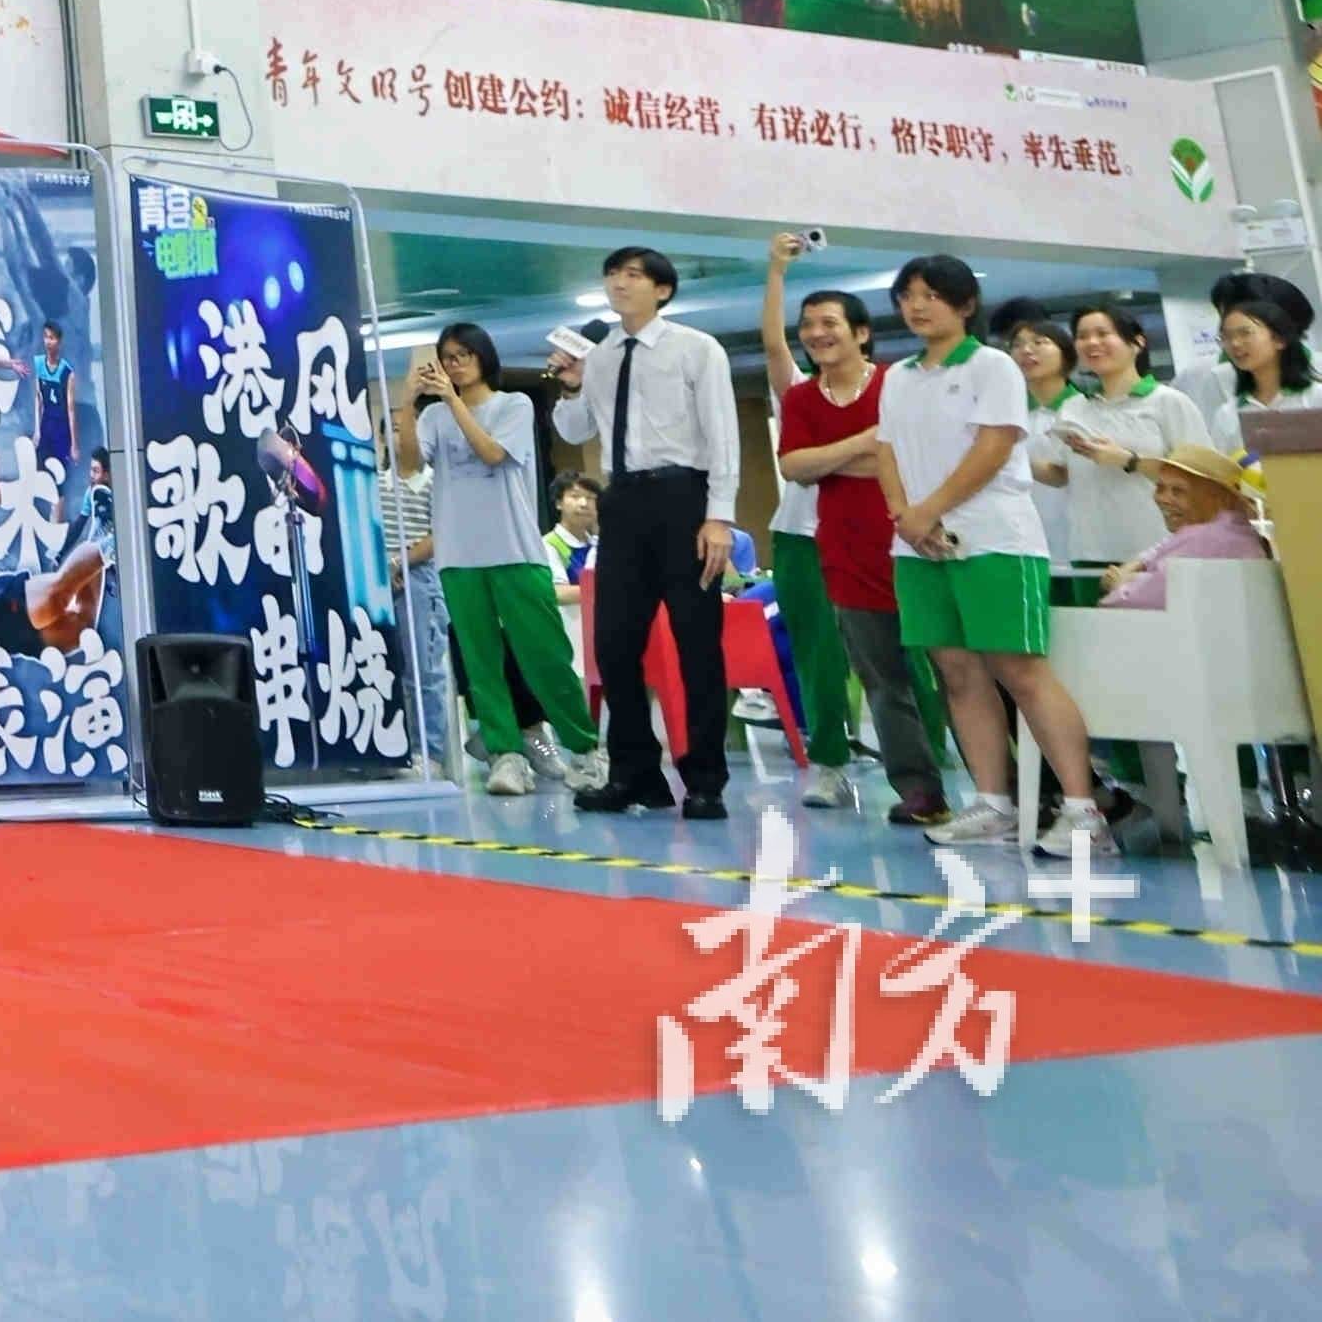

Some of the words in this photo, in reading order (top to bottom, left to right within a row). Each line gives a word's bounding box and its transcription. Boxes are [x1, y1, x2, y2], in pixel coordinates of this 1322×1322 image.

[138, 185, 191, 232] 青宫
[155, 228, 219, 280] 电影城
[198, 299, 372, 441] 港风
